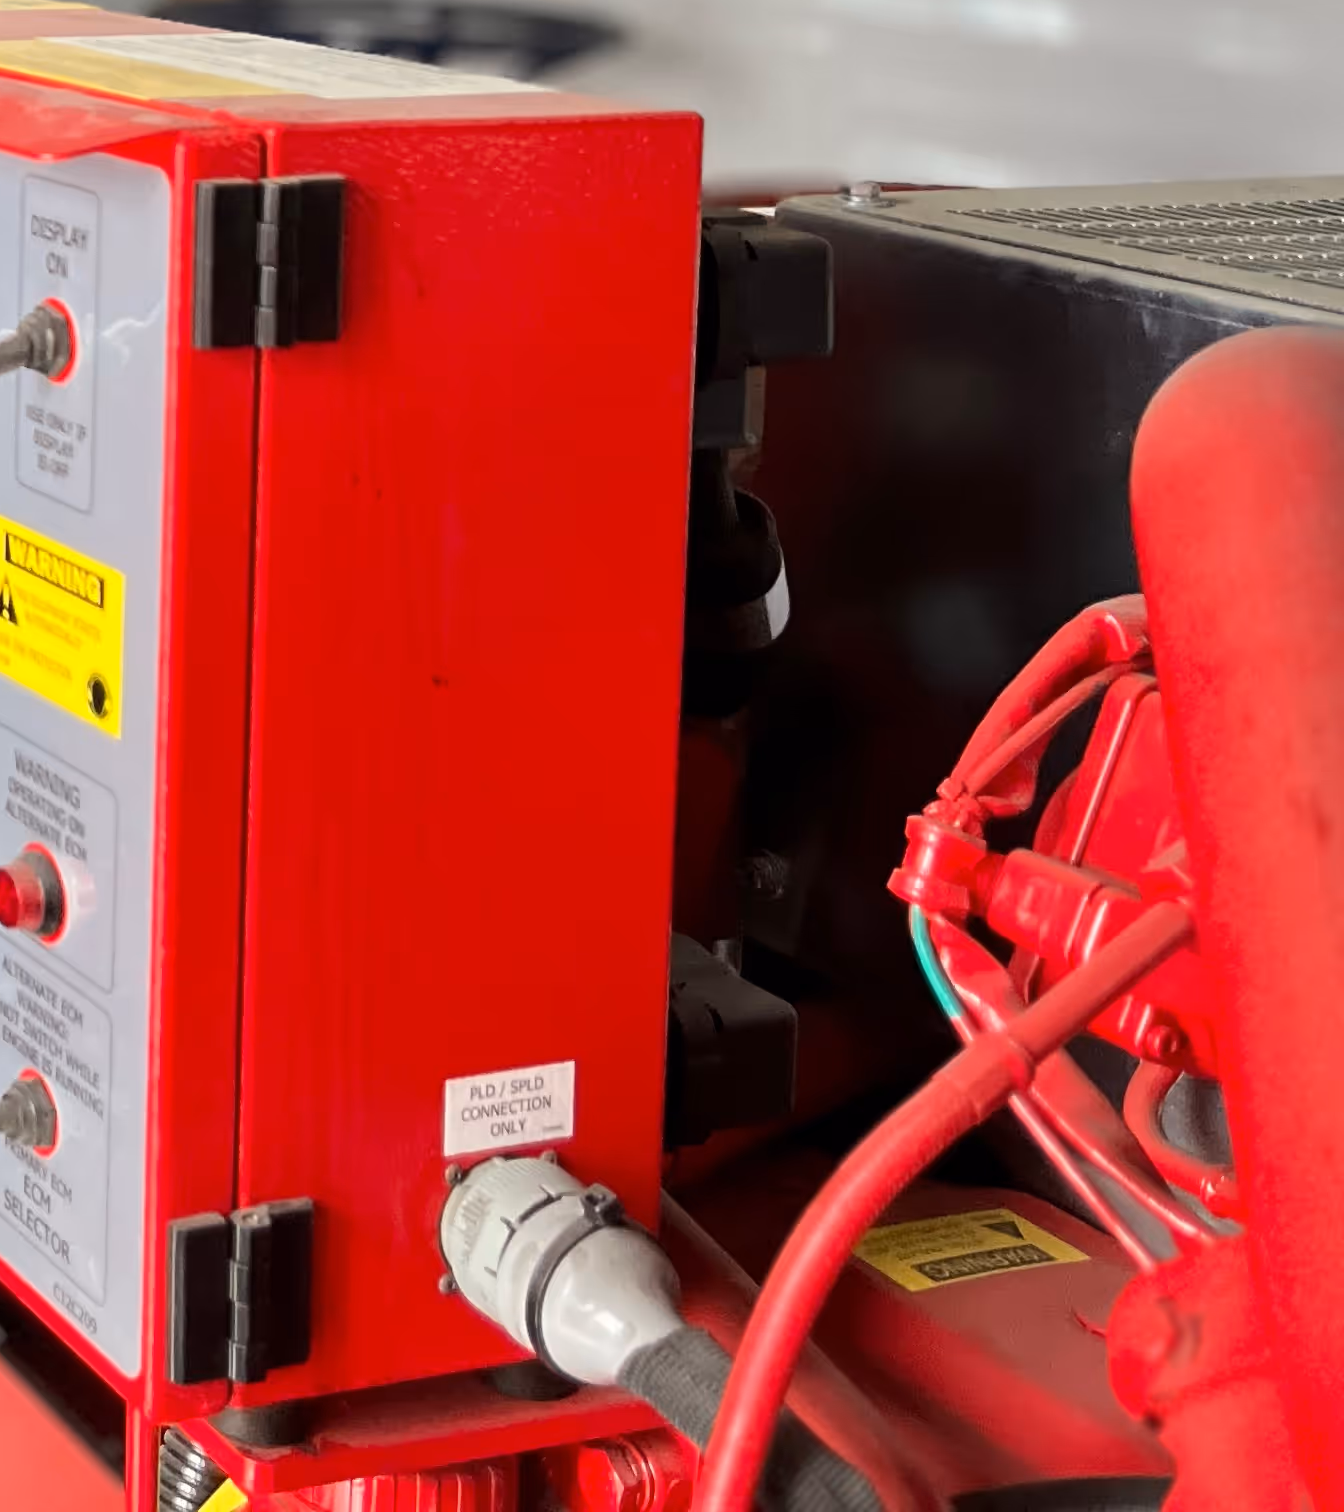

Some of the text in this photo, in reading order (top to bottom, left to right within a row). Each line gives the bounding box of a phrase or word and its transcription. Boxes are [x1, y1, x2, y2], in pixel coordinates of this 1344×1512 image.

[31, 214, 88, 250] DISPLAY
[46, 252, 68, 278] ON
[9, 533, 102, 607] WARNING
[8, 776, 86, 839] OPERATING ON
[14, 748, 80, 810] WARNING
[5, 794, 87, 861] ALTERNATE ECM
[3, 955, 84, 1029] ALTERNATE ECM
[0, 1001, 20, 1025] NOT
[22, 1018, 63, 1060] SWITCH
[65, 1049, 100, 1089] WHILE
[2, 1025, 39, 1067] ENGINE
[41, 1055, 52, 1077] IS
[55, 1066, 104, 1120] RUNNING
[461, 1095, 552, 1122] CONNECTION
[470, 1084, 495, 1101] PLD
[510, 1076, 544, 1093] SPLD
[490, 1118, 527, 1137] ONLY
[5, 1137, 72, 1203] PRIMARY ECM
[23, 1174, 51, 1213] ECM
[4, 1188, 70, 1264] SELECTOR
[924, 1245, 1042, 1280] WARNING
